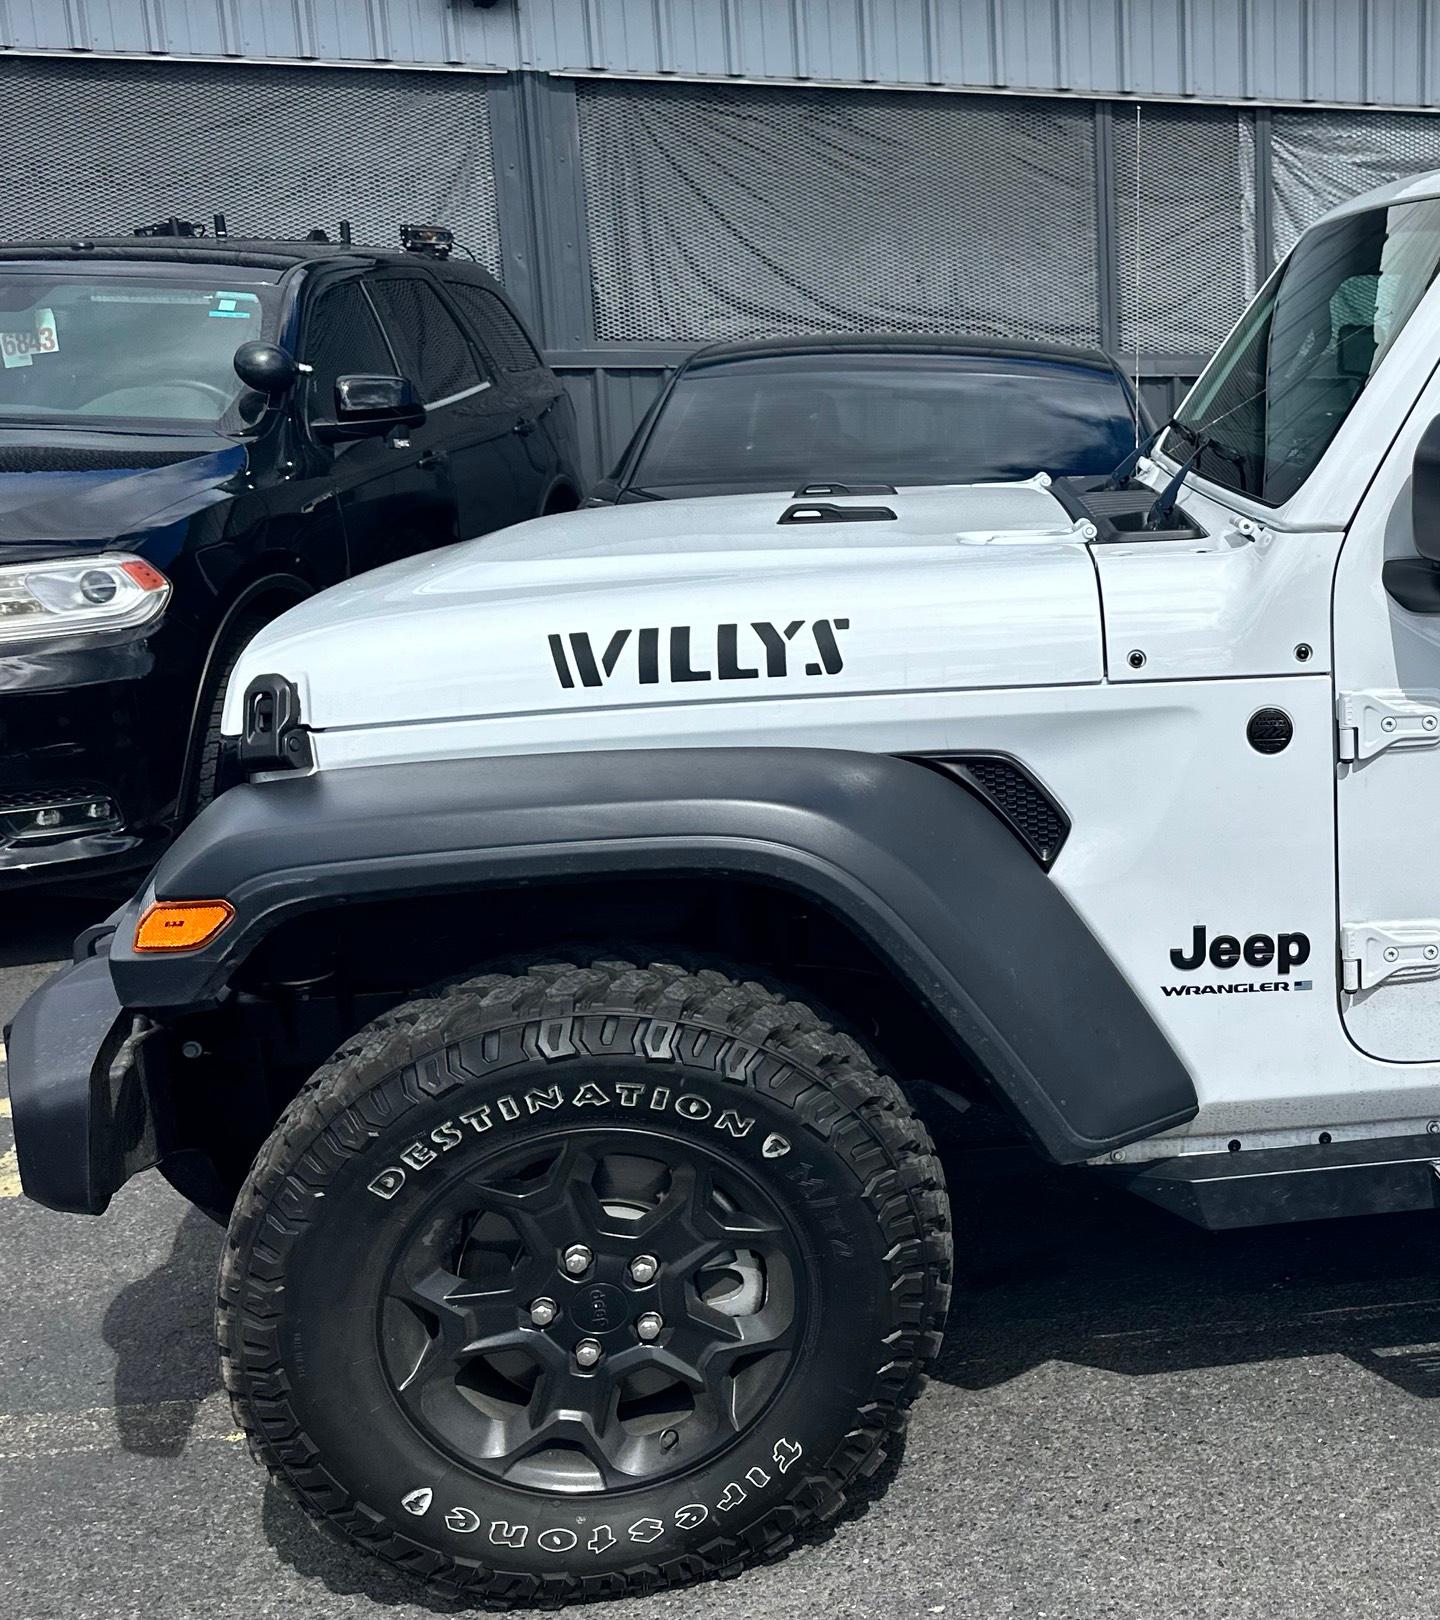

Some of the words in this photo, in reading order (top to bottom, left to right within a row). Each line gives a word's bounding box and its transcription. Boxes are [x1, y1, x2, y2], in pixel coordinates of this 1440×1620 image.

[548, 618, 850, 688] WILLYS
[1169, 925, 1311, 975] Jeep
[1160, 981, 1290, 996] WRANGLER
[367, 1082, 757, 1200] DESTINATION
[445, 1438, 802, 1554] Firestone
